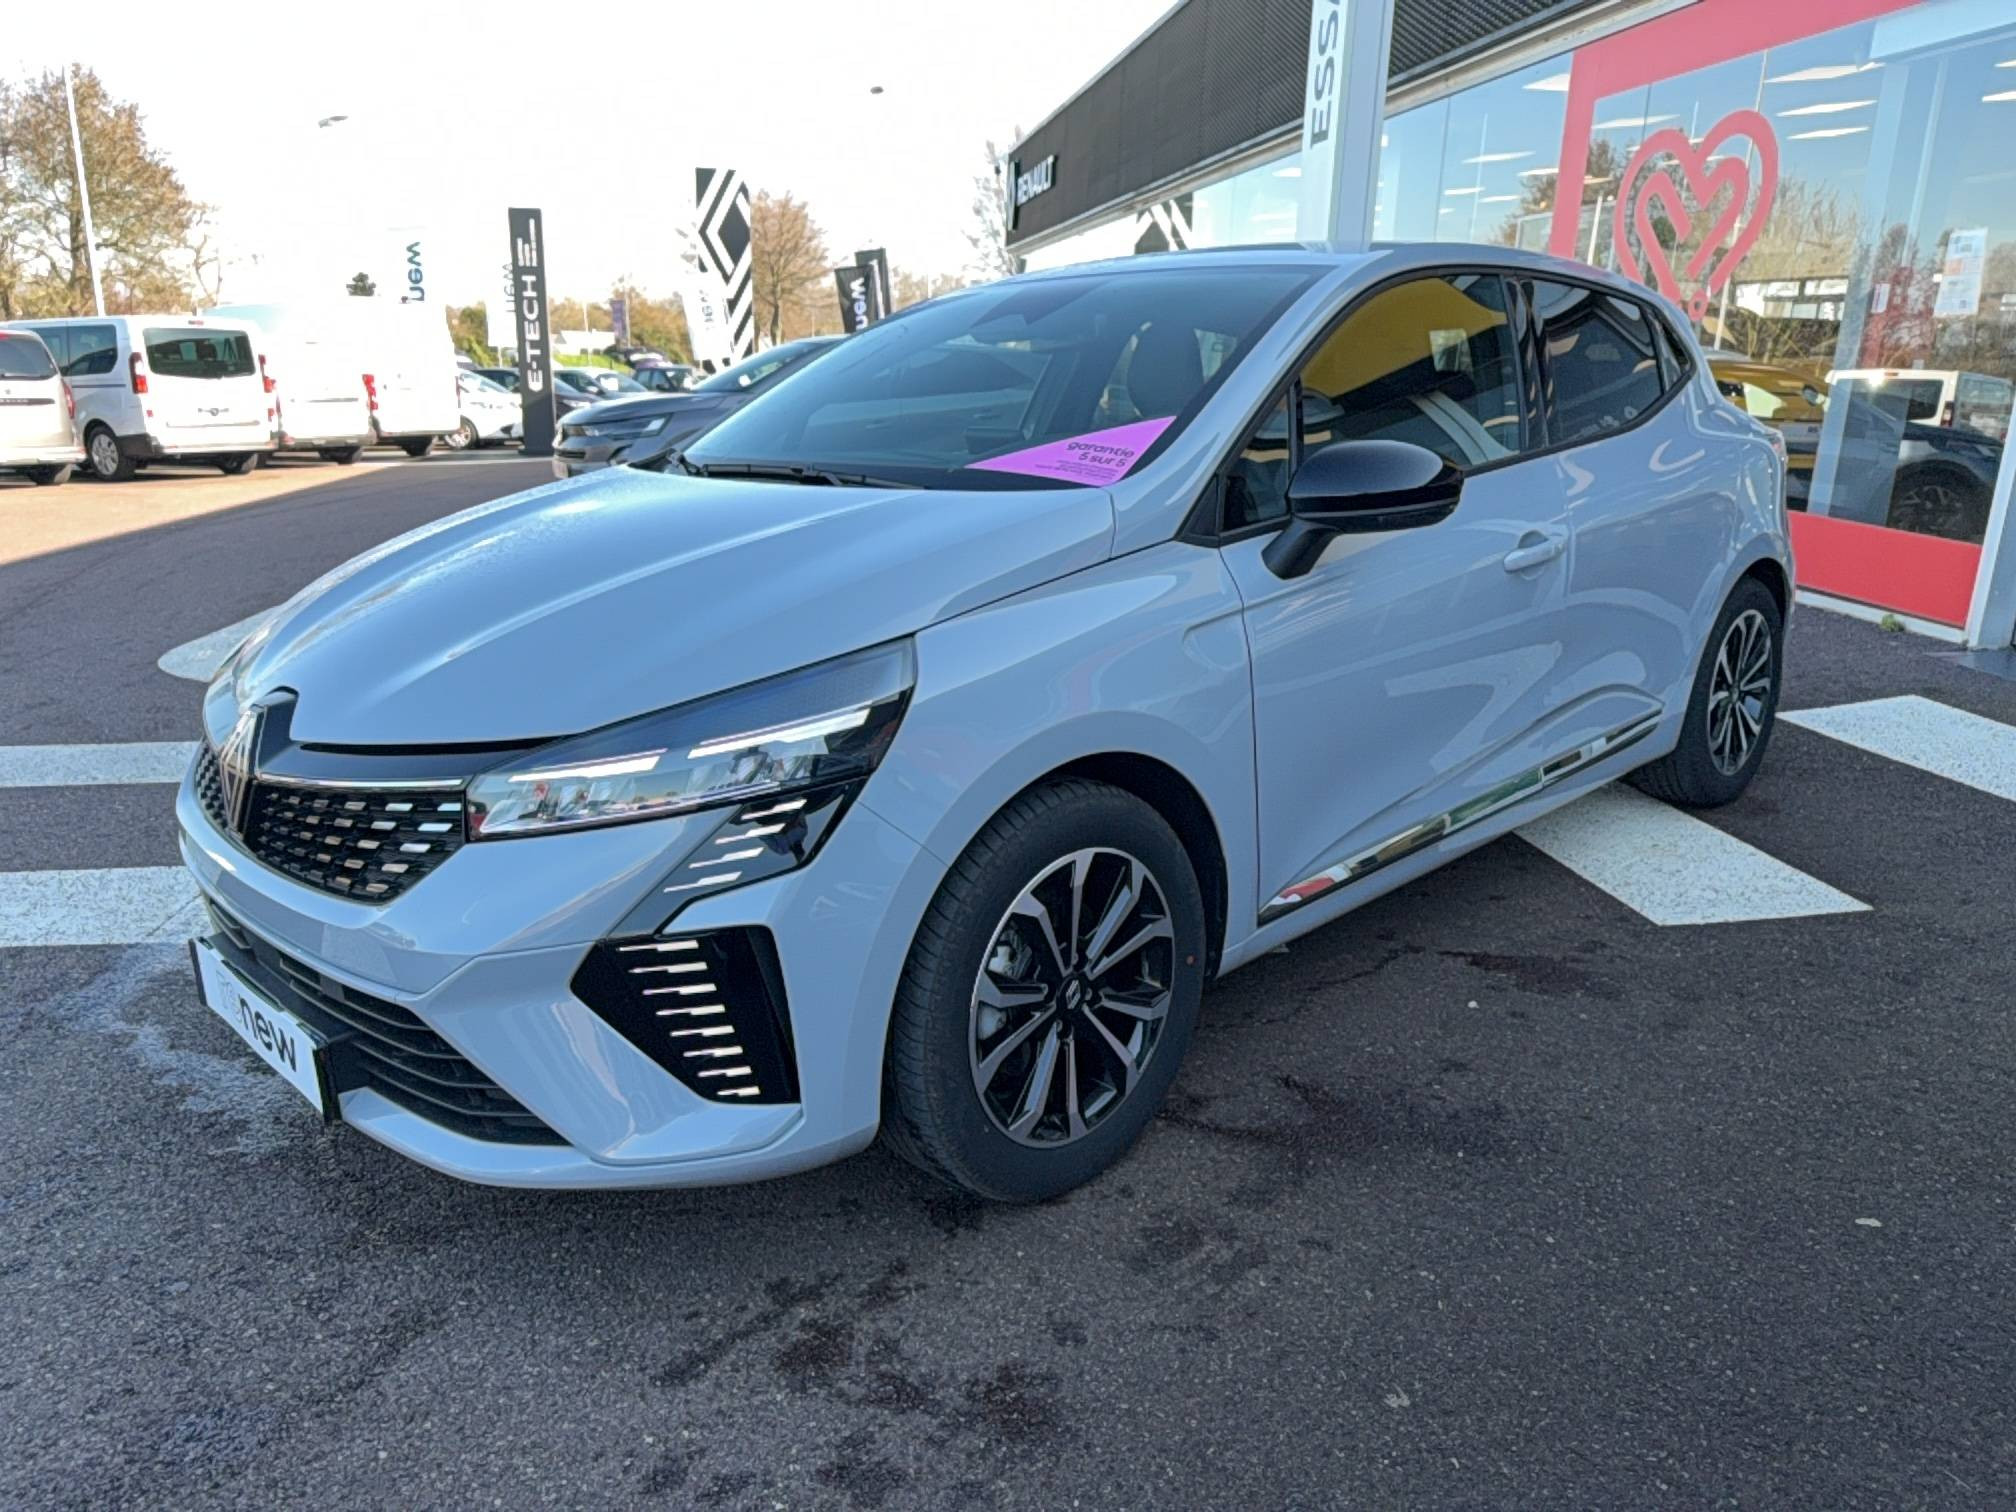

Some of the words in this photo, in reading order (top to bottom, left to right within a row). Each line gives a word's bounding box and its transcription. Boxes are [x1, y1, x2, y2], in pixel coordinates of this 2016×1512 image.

[1310, 0, 1340, 149] ESS
[1017, 155, 1055, 206] RENAULT
[521, 275, 543, 392] E-TECH
[1066, 442, 1135, 458] garantie
[1079, 452, 1090, 461] 5
[1090, 455, 1116, 465] sur
[1115, 459, 1127, 468] 5
